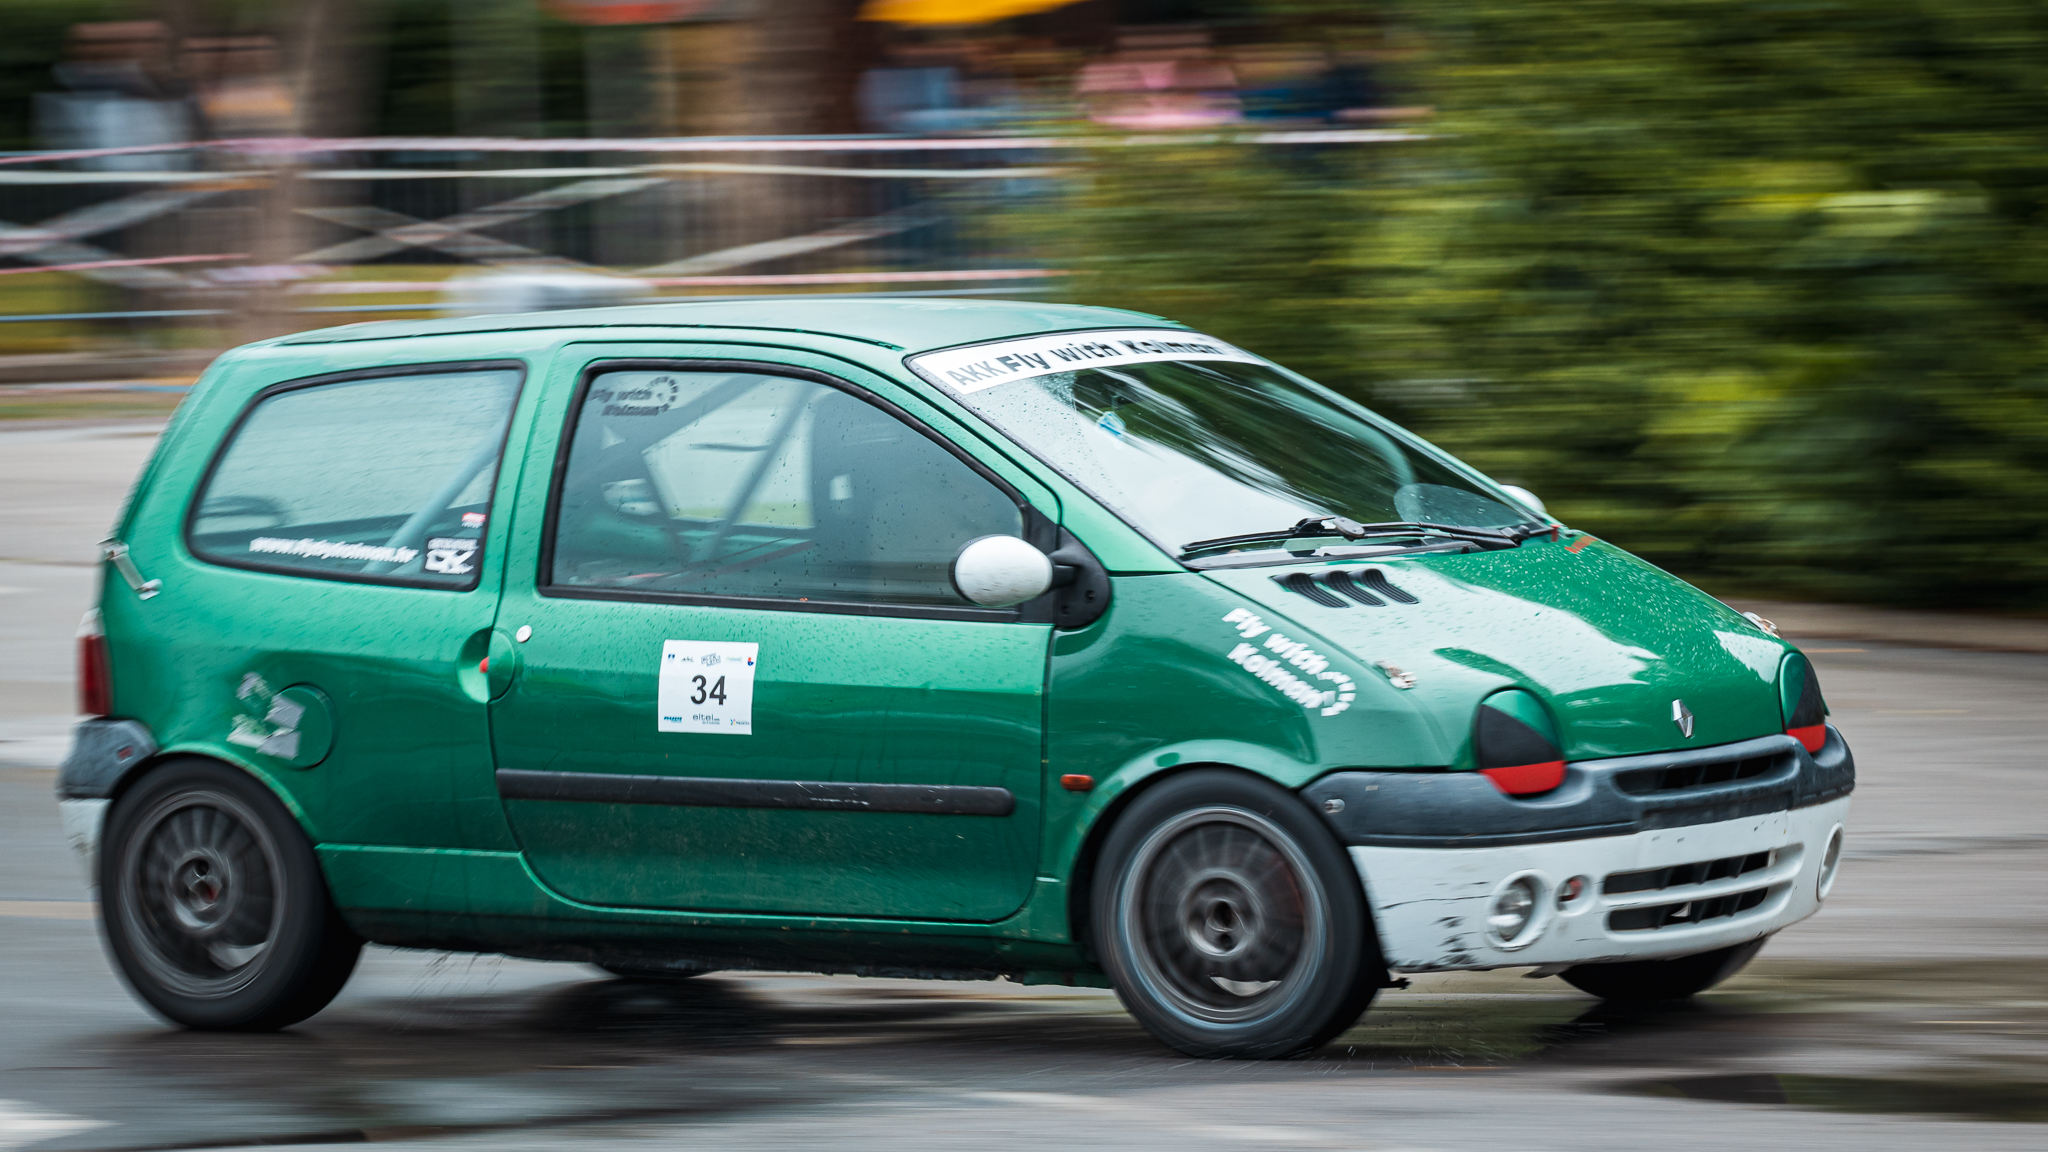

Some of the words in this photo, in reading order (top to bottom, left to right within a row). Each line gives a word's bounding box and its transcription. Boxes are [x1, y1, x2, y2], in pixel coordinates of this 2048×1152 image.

[946, 360, 1007, 386] AKK
[995, 353, 1051, 371] Fly
[1049, 342, 1122, 362] with
[1221, 608, 1272, 638] Fly
[1262, 633, 1330, 675] with
[690, 674, 727, 706] 34
